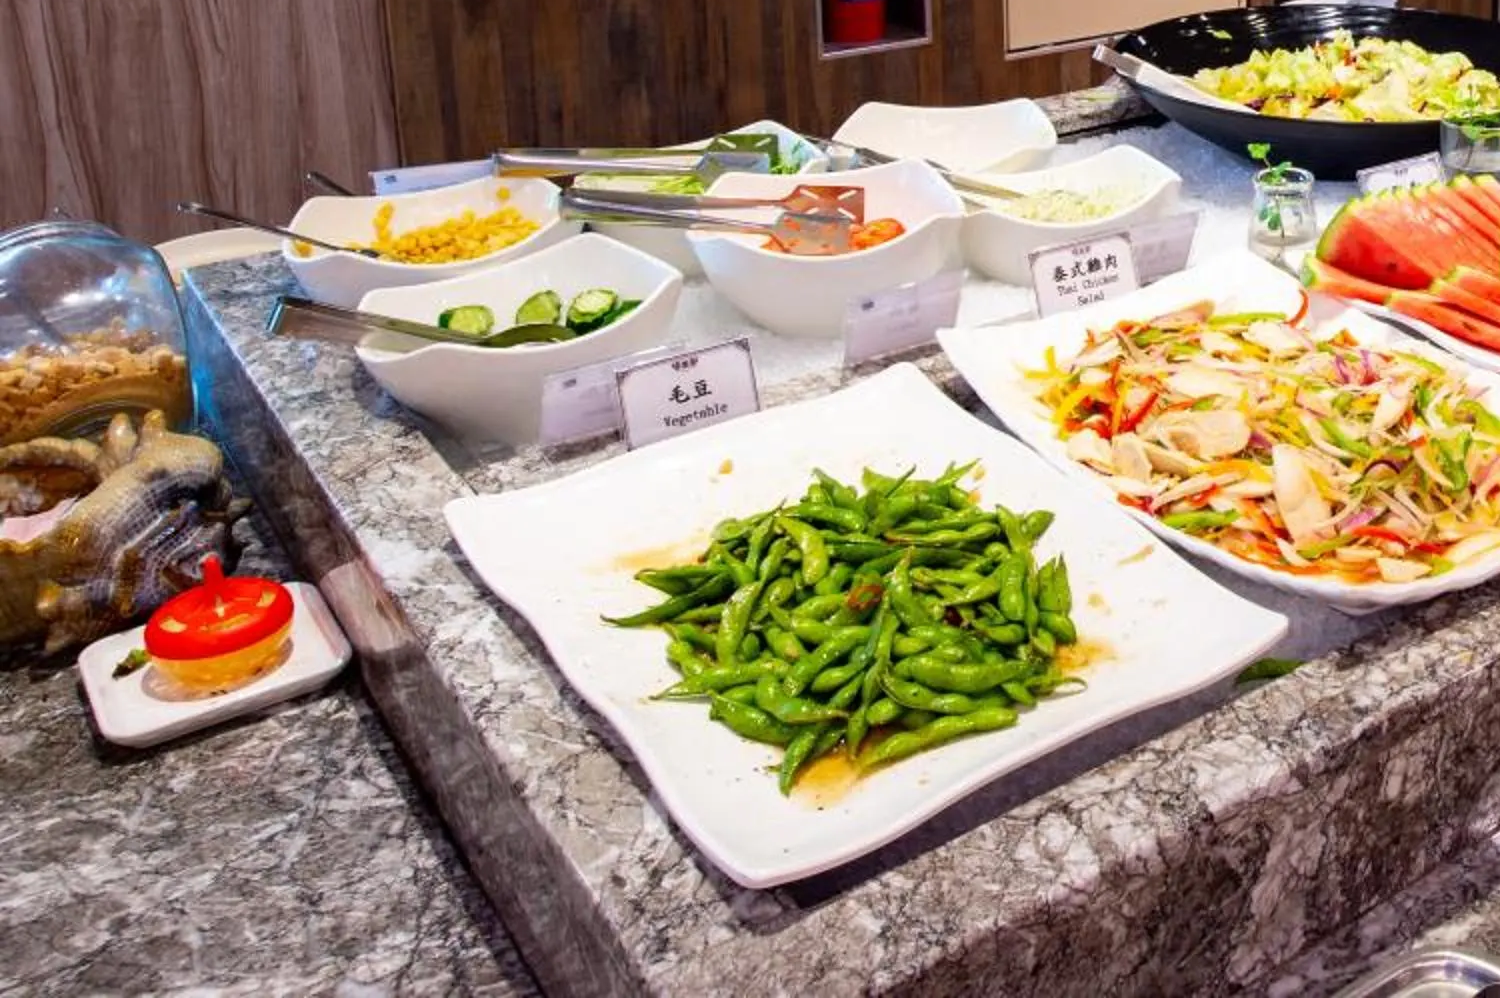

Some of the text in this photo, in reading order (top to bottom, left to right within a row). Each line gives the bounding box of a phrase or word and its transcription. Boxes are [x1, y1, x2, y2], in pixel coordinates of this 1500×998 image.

[1077, 290, 1105, 306] Salad
[668, 379, 713, 404] 毛豆
[663, 403, 729, 427] Vegetable
